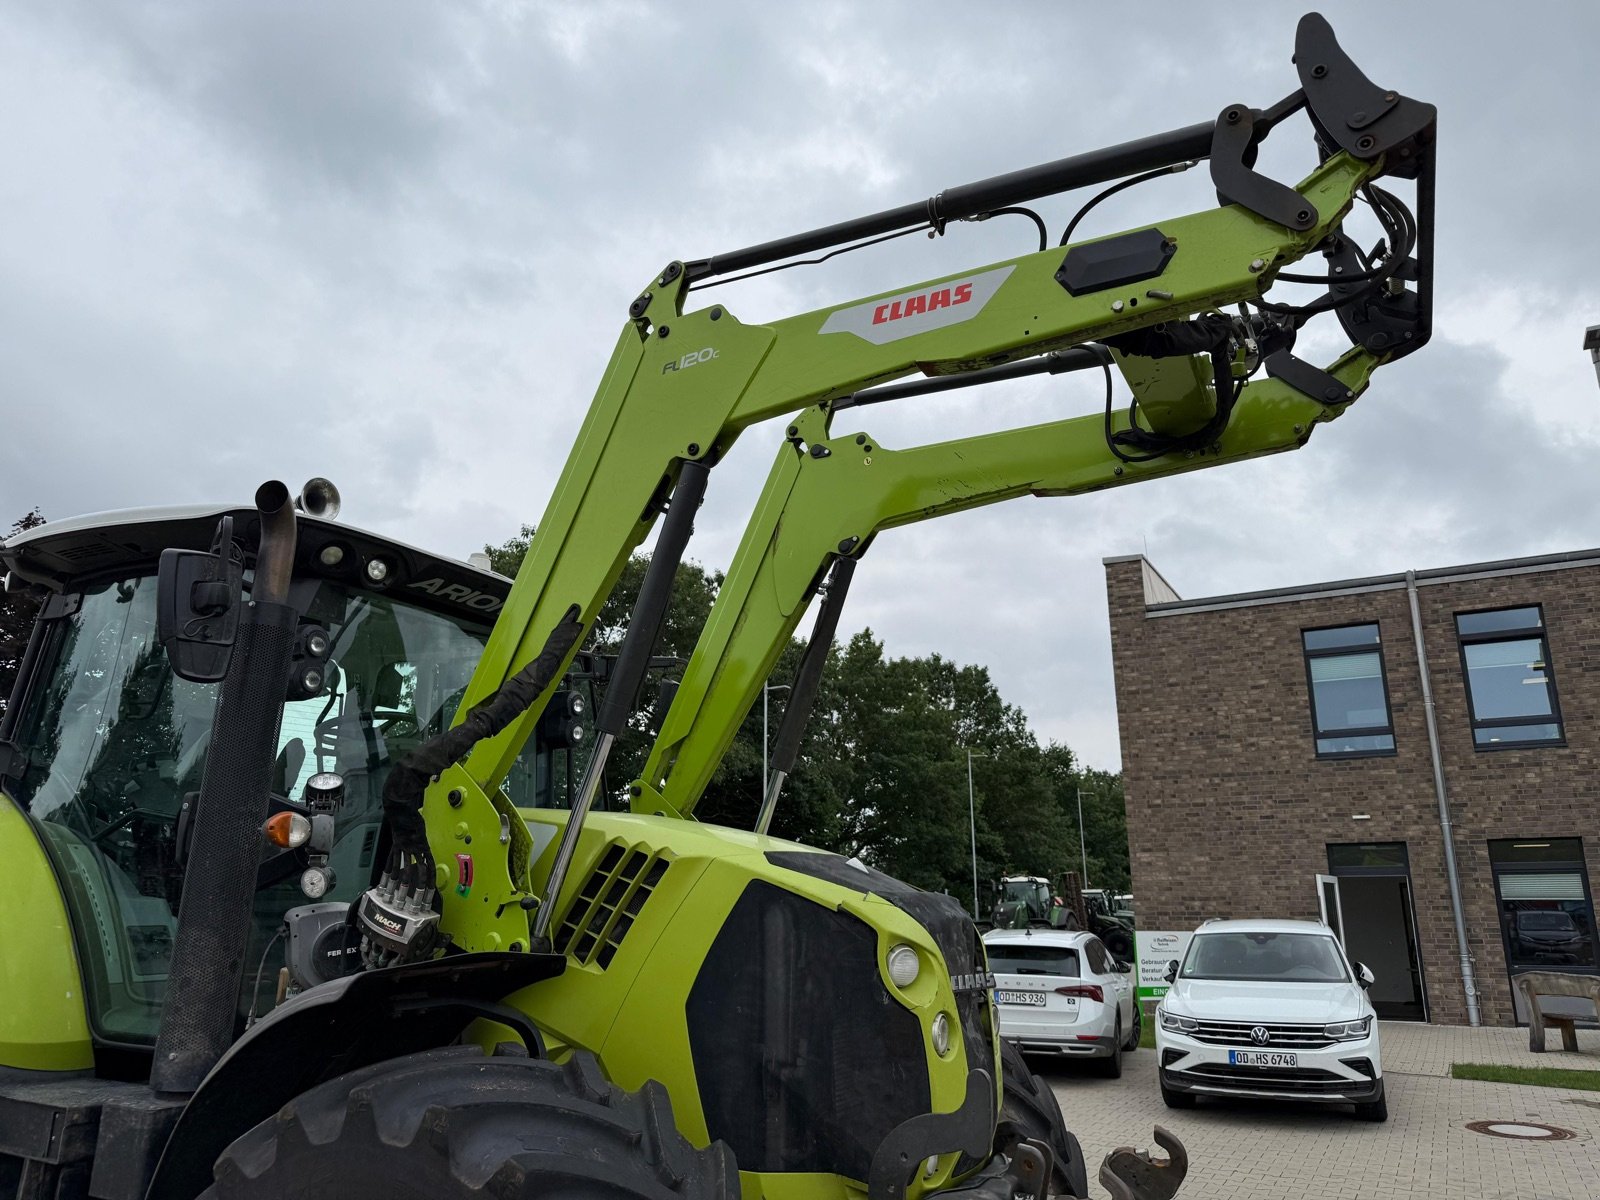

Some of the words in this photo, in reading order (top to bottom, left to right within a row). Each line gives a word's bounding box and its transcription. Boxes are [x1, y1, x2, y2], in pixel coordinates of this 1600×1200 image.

[872, 282, 973, 326] CLAAS
[374, 913, 402, 931] MACH
[327, 946, 358, 958] FEREX
[950, 971, 997, 991] CLAAS
[999, 992, 1012, 1002] OD
[1015, 993, 1028, 1003] HS
[1028, 993, 1045, 1004] 936
[1236, 1052, 1249, 1064] OD
[1255, 1053, 1269, 1065] HS
[1270, 1054, 1296, 1066] 6748
